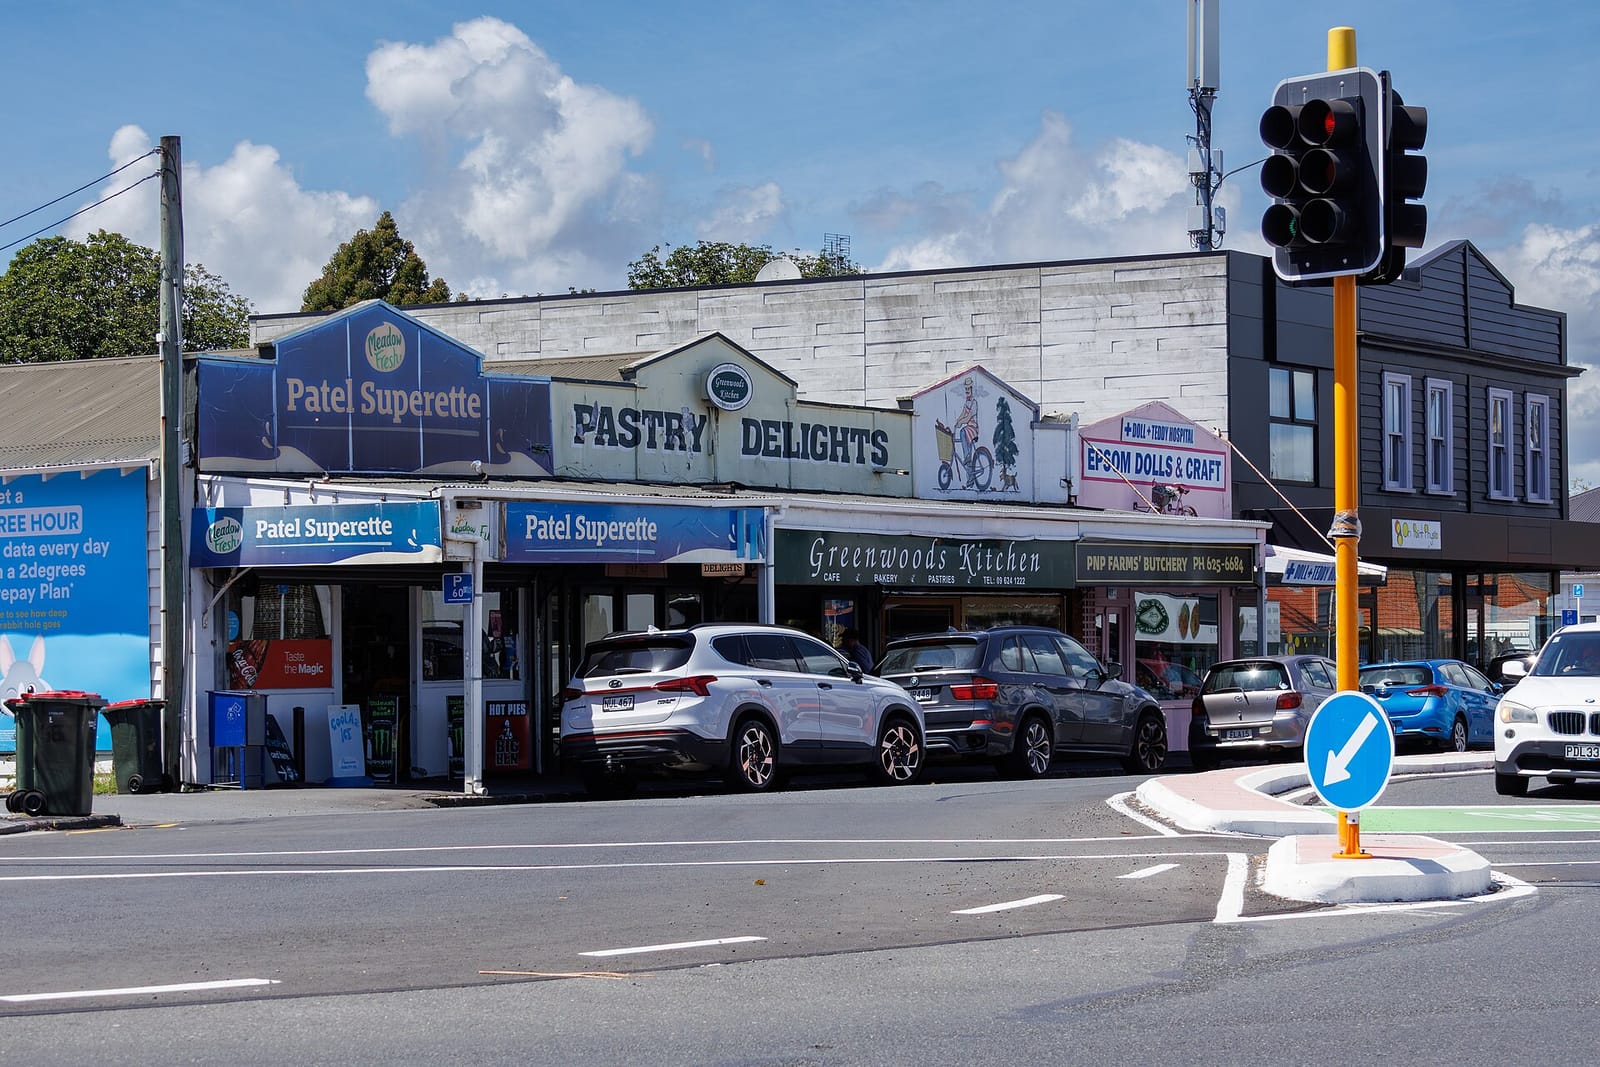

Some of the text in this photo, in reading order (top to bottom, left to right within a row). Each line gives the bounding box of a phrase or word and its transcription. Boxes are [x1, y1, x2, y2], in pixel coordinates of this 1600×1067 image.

[368, 326, 402, 357] Meadow
[374, 347, 400, 369] Fresh
[715, 377, 745, 388] Greenwoods
[286, 378, 481, 424] Patel Superette
[573, 403, 890, 467] PASTRY DELIGHTS
[1132, 422, 1147, 439] DOLL
[1151, 424, 1169, 441] TEDDY
[1169, 427, 1194, 444] HOSPITAL
[1087, 448, 1222, 482] EPSOM DOLLS & CRAFT
[15, 491, 24, 504] a
[0, 511, 79, 533] REE HOUR
[208, 520, 240, 543] Meadow
[256, 517, 393, 541] Patel Superette
[525, 514, 657, 546] Patel Superette
[3, 537, 110, 559] data every day
[214, 535, 236, 552] Fresh
[809, 537, 1041, 577] Greenwoods Kitchen
[1086, 555, 1244, 574] PNP FARMS' BUTCHERY PH 625-6684
[20, 561, 86, 581] 2degrees
[703, 563, 743, 573] DELIGHTS
[453, 575, 463, 587] P
[823, 572, 841, 582] CAFE
[873, 573, 898, 583] BAKERY
[928, 574, 955, 584] PASTRIES
[983, 575, 996, 585] TEL:
[996, 576, 1003, 585] 09
[1014, 576, 1026, 585] 1222
[452, 588, 464, 598] 60
[284, 651, 305, 662] Taste
[284, 663, 324, 675] the Magic
[489, 703, 527, 716] HOT PIES
[1566, 746, 1600, 758] PDL33
